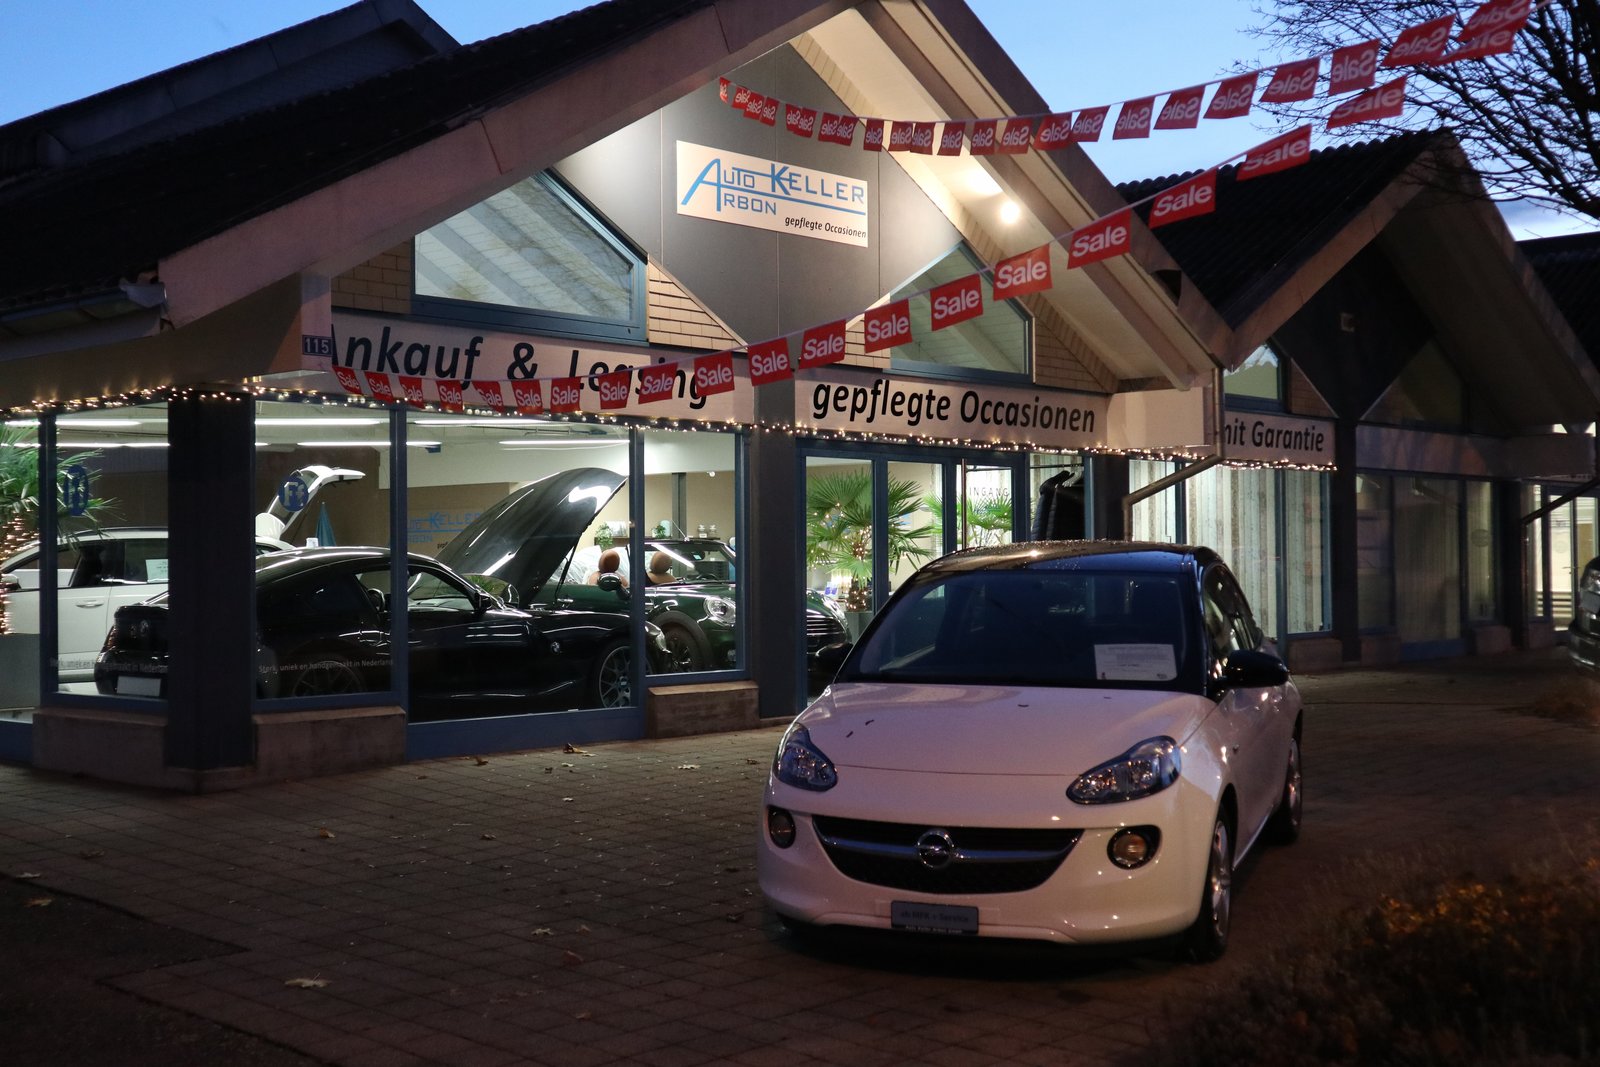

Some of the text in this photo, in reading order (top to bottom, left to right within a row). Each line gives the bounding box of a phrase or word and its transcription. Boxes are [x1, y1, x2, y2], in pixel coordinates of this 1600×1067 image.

[1336, 86, 1404, 117] Sale
[1245, 137, 1309, 171] Sale
[681, 158, 865, 212] AUTO KELLER
[1153, 181, 1214, 219] Sale
[785, 216, 867, 238] gepflegte Occasionen
[1071, 226, 1129, 257] Sale
[996, 258, 1048, 289] Sale
[933, 288, 980, 320] Sale
[866, 315, 910, 342] Sale
[304, 337, 330, 355] 115
[803, 332, 845, 361] Sale
[507, 342, 538, 380] &
[751, 350, 789, 377] Sale
[337, 371, 360, 389] Sale
[368, 378, 390, 396] Sale
[641, 373, 674, 395] Sale
[696, 364, 733, 388] Sale
[440, 385, 462, 405] Sale
[515, 386, 543, 407] Sale
[551, 386, 579, 406] Sale
[600, 381, 628, 401] Sale
[813, 379, 1095, 433] gepflegte Occasionen
[1252, 421, 1325, 452] Garantie
[968, 486, 1010, 497] INGANG
